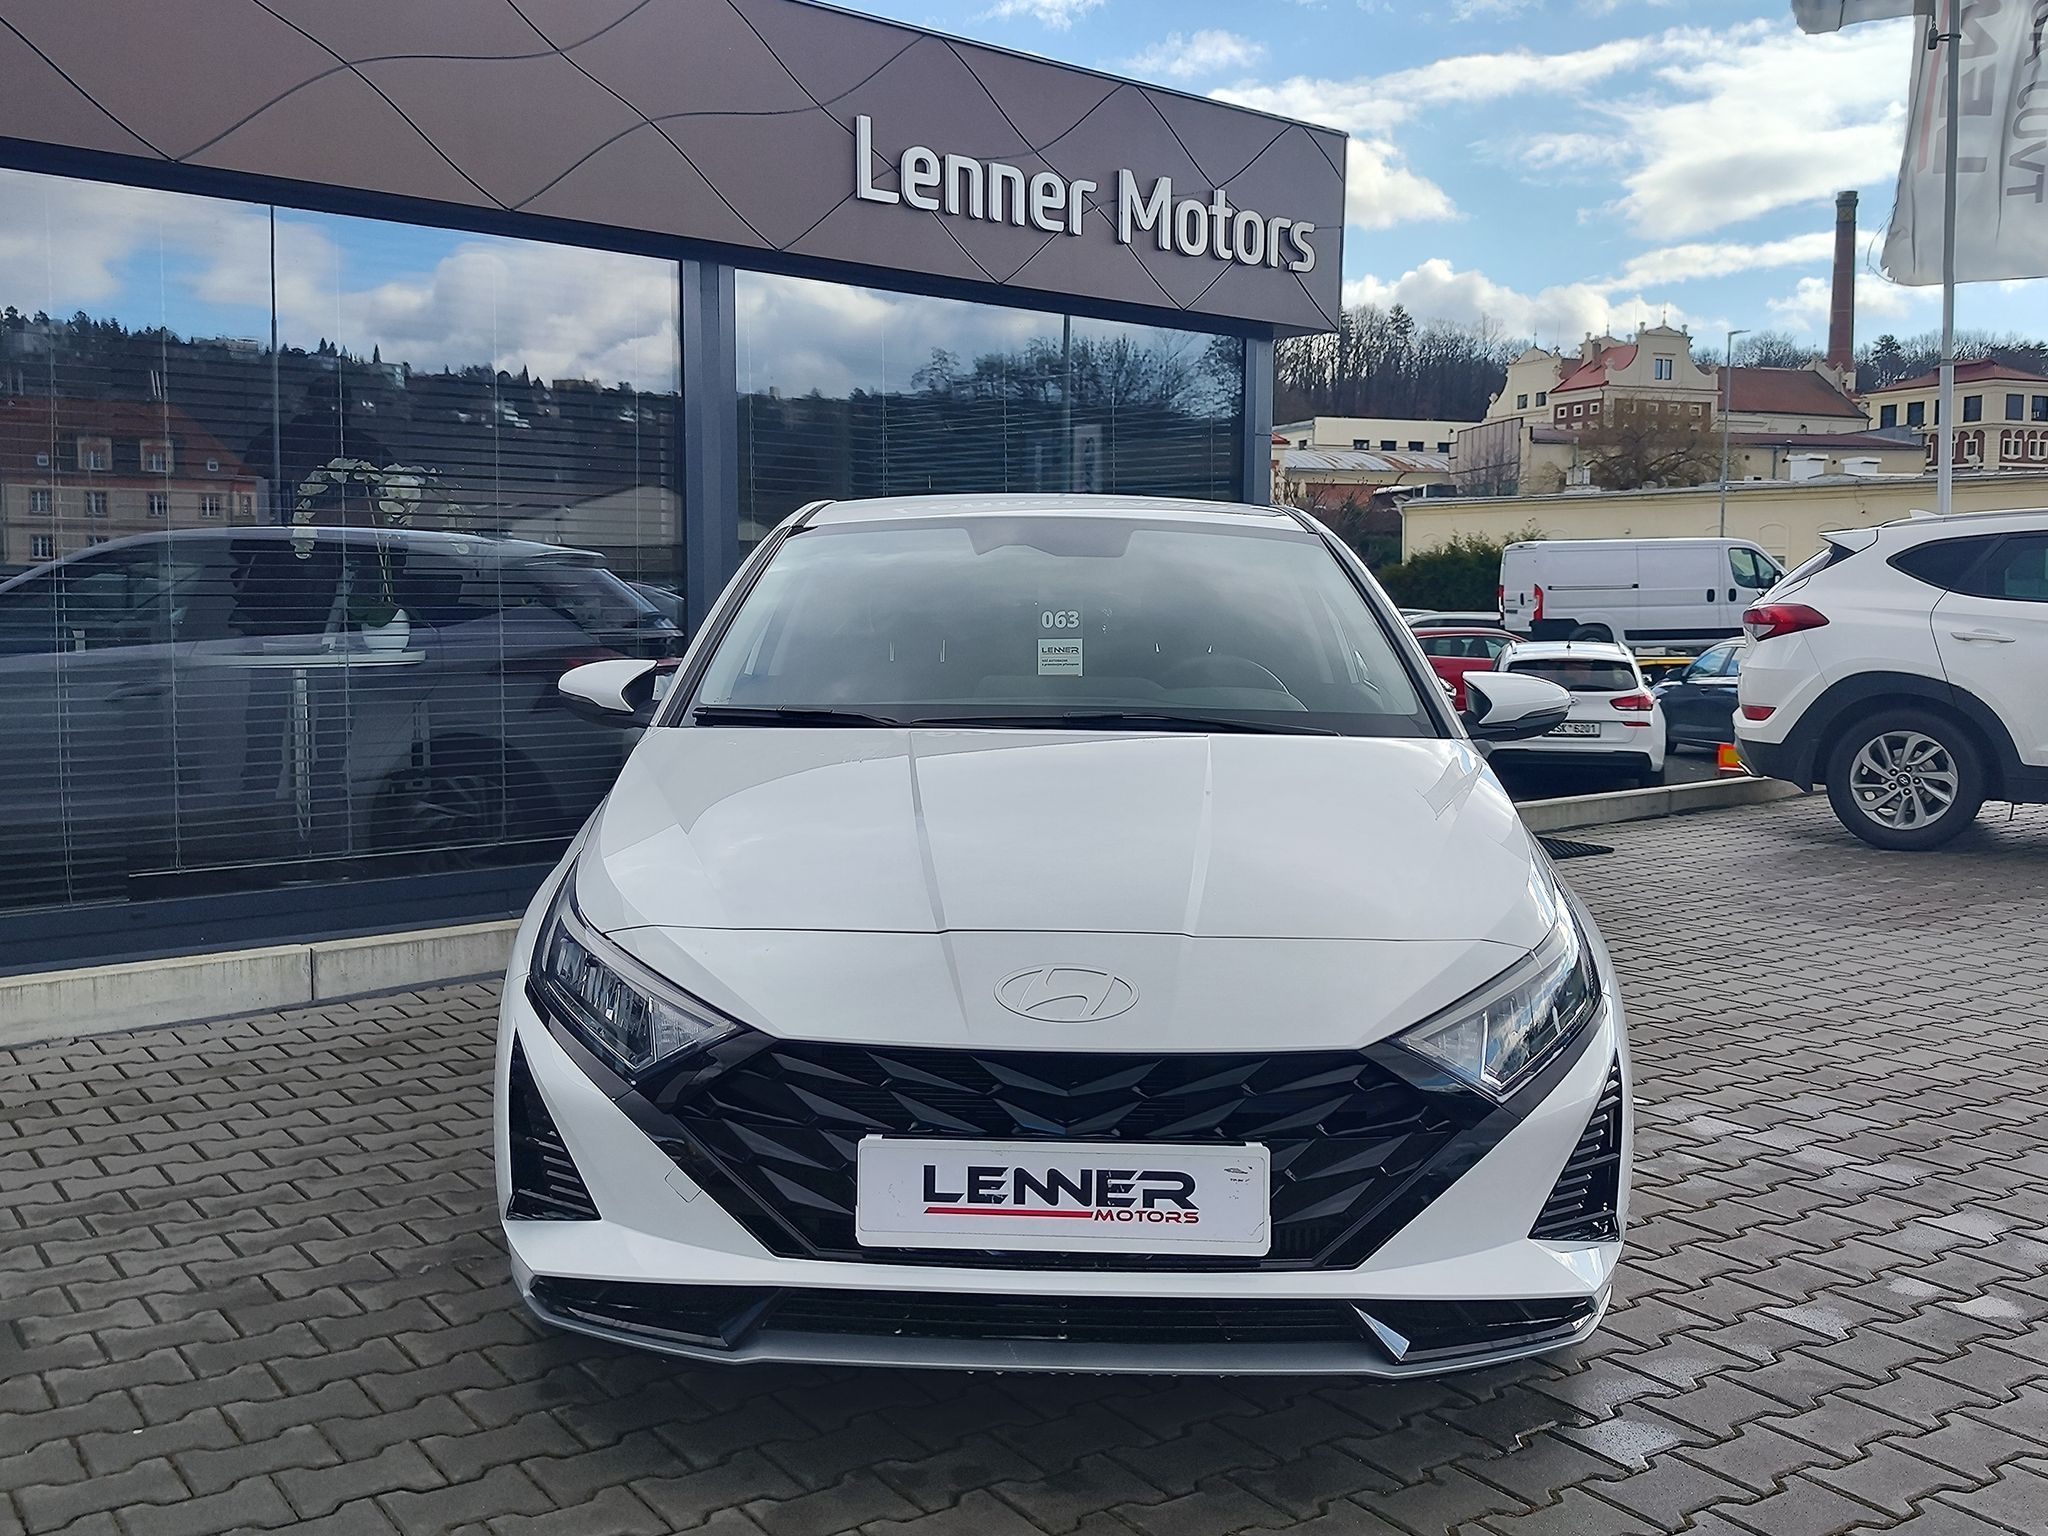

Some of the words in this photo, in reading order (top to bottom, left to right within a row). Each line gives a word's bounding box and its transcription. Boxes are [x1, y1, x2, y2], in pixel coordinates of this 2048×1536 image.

[854, 114, 1098, 237] Lenner
[1116, 168, 1316, 273] Motors
[1041, 610, 1080, 629] 063
[1041, 646, 1080, 654] LENNER
[923, 1164, 1197, 1209] LENNER
[1093, 1208, 1200, 1224] MOTORS
